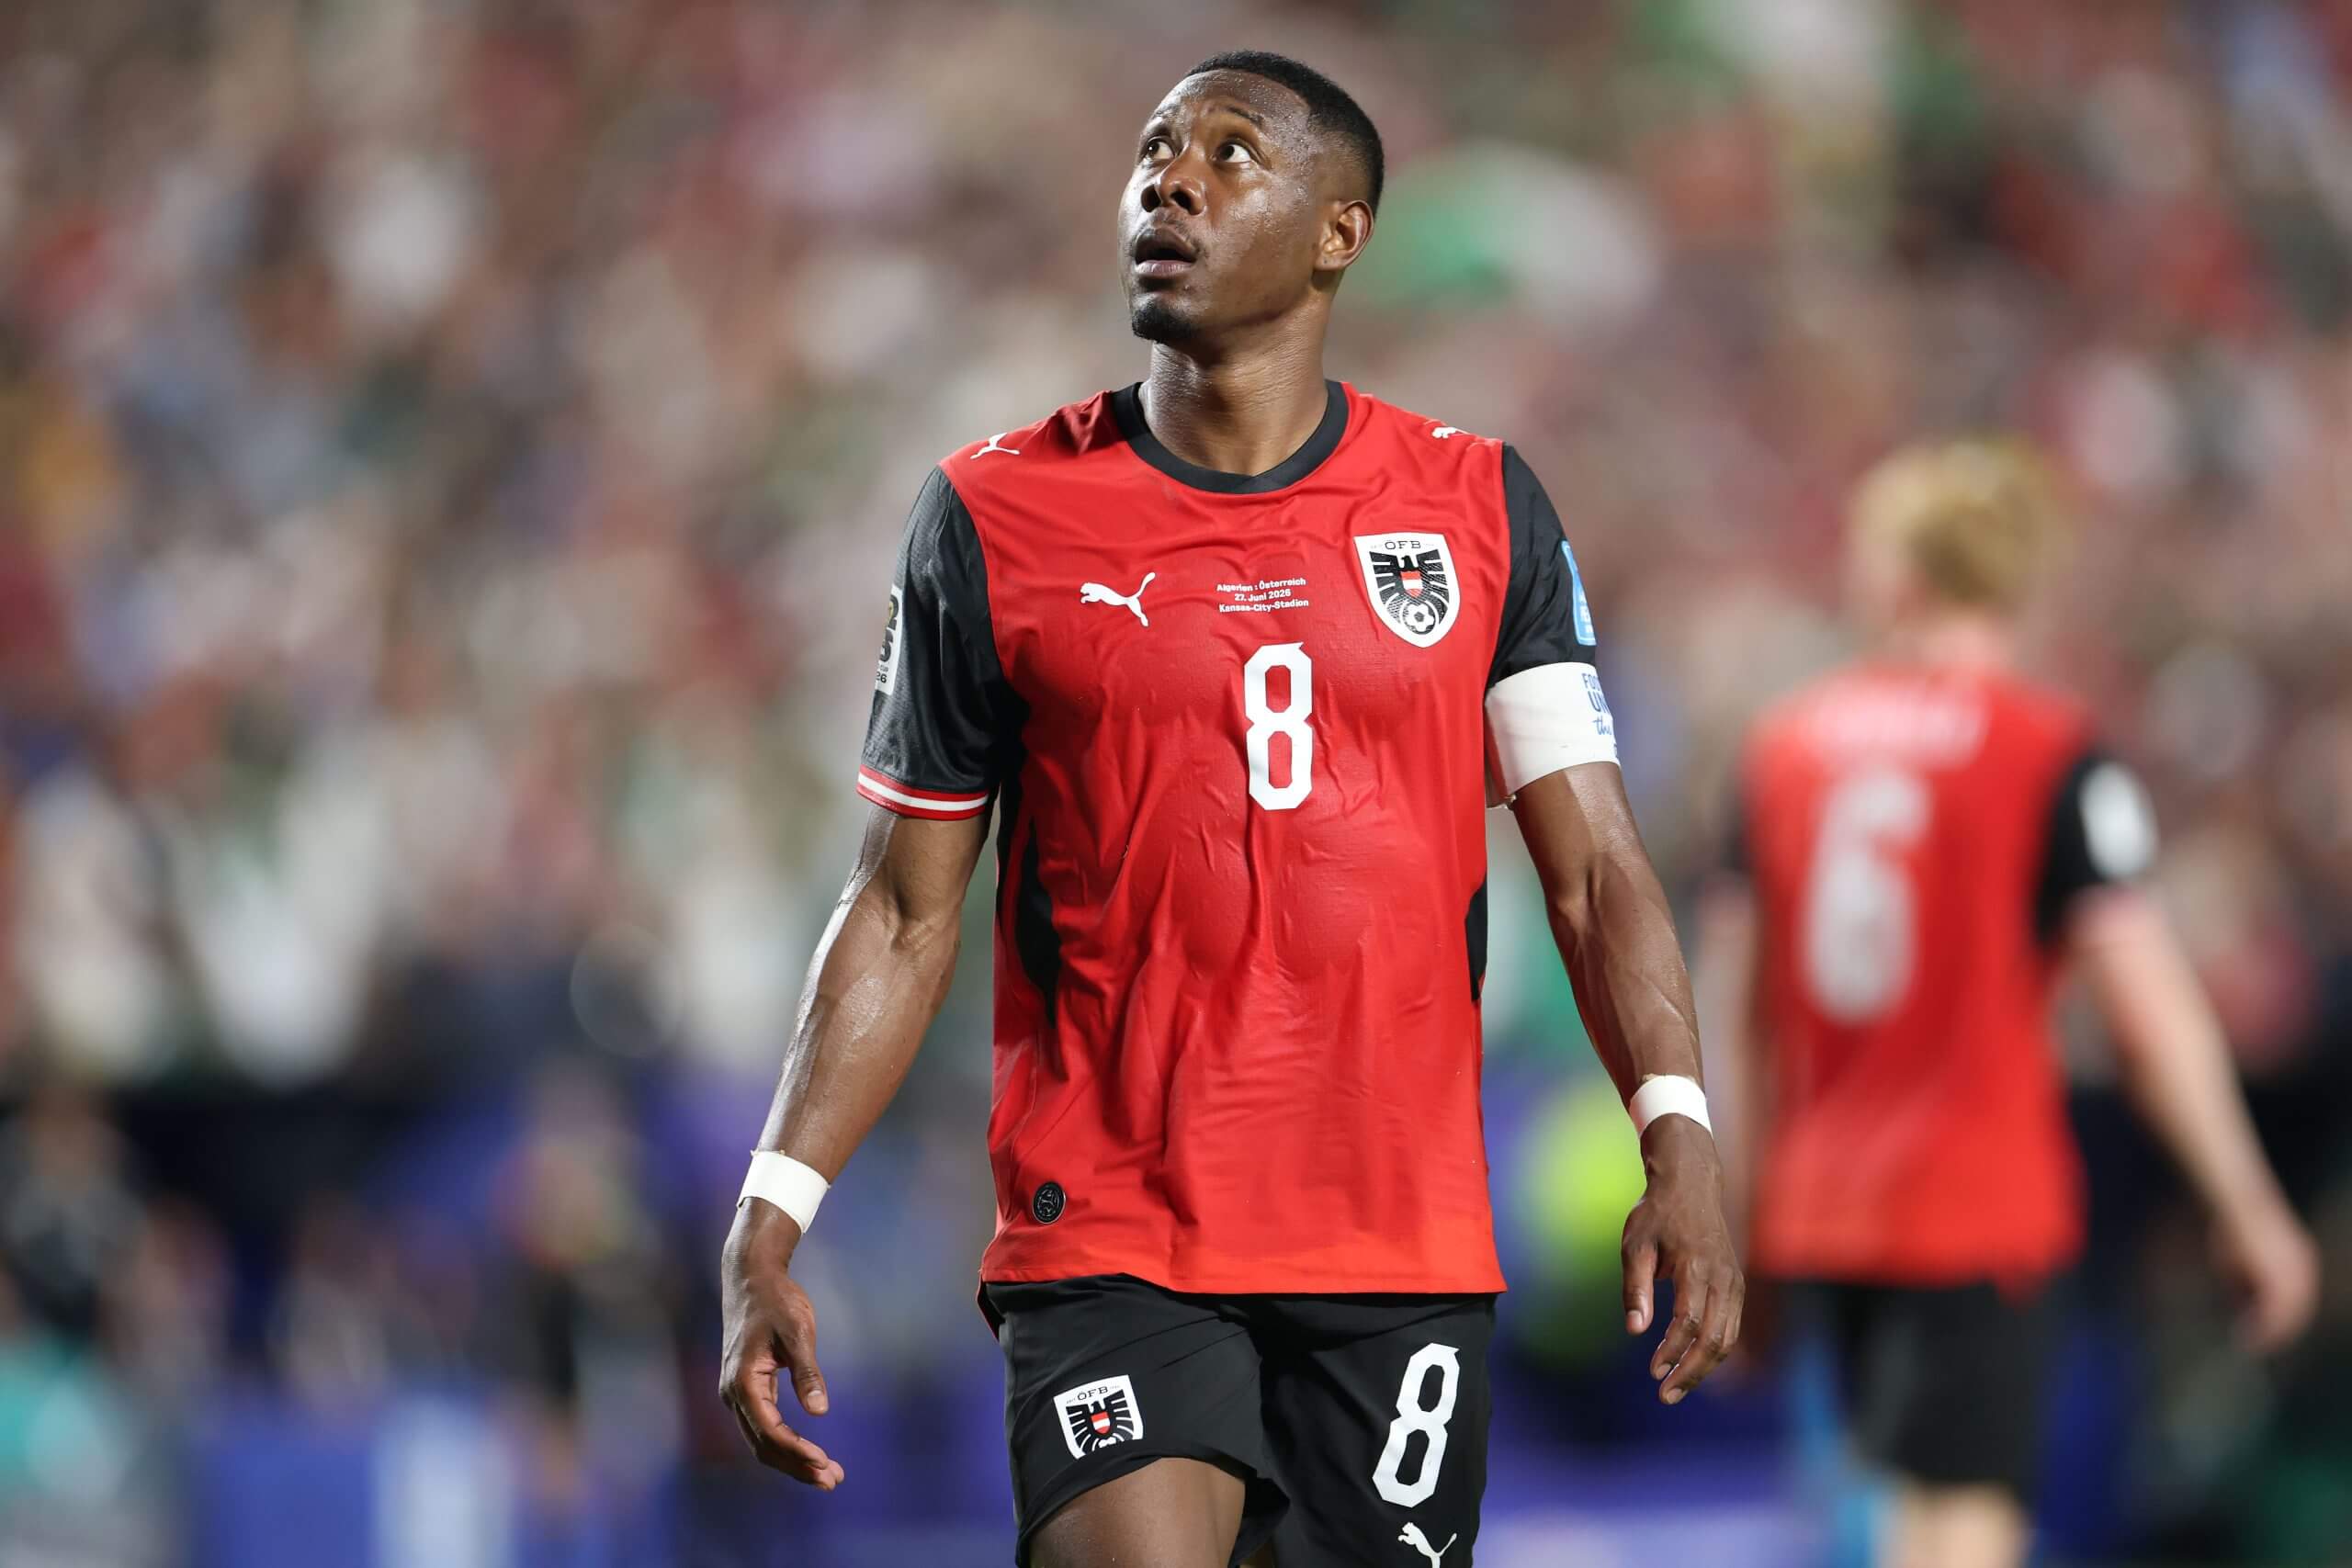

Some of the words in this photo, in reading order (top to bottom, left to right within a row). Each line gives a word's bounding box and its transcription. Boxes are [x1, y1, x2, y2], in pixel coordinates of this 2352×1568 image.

[1216, 583, 1253, 592] Algerien
[1259, 578, 1306, 590] Österreich
[1234, 593, 1247, 602] 27.
[1248, 592, 1267, 602] Juni
[1268, 589, 1291, 600] 2026
[1219, 599, 1309, 614] Kansas-City-Stadion
[1244, 642, 1314, 810] 8
[1372, 1342, 1461, 1508] 8
